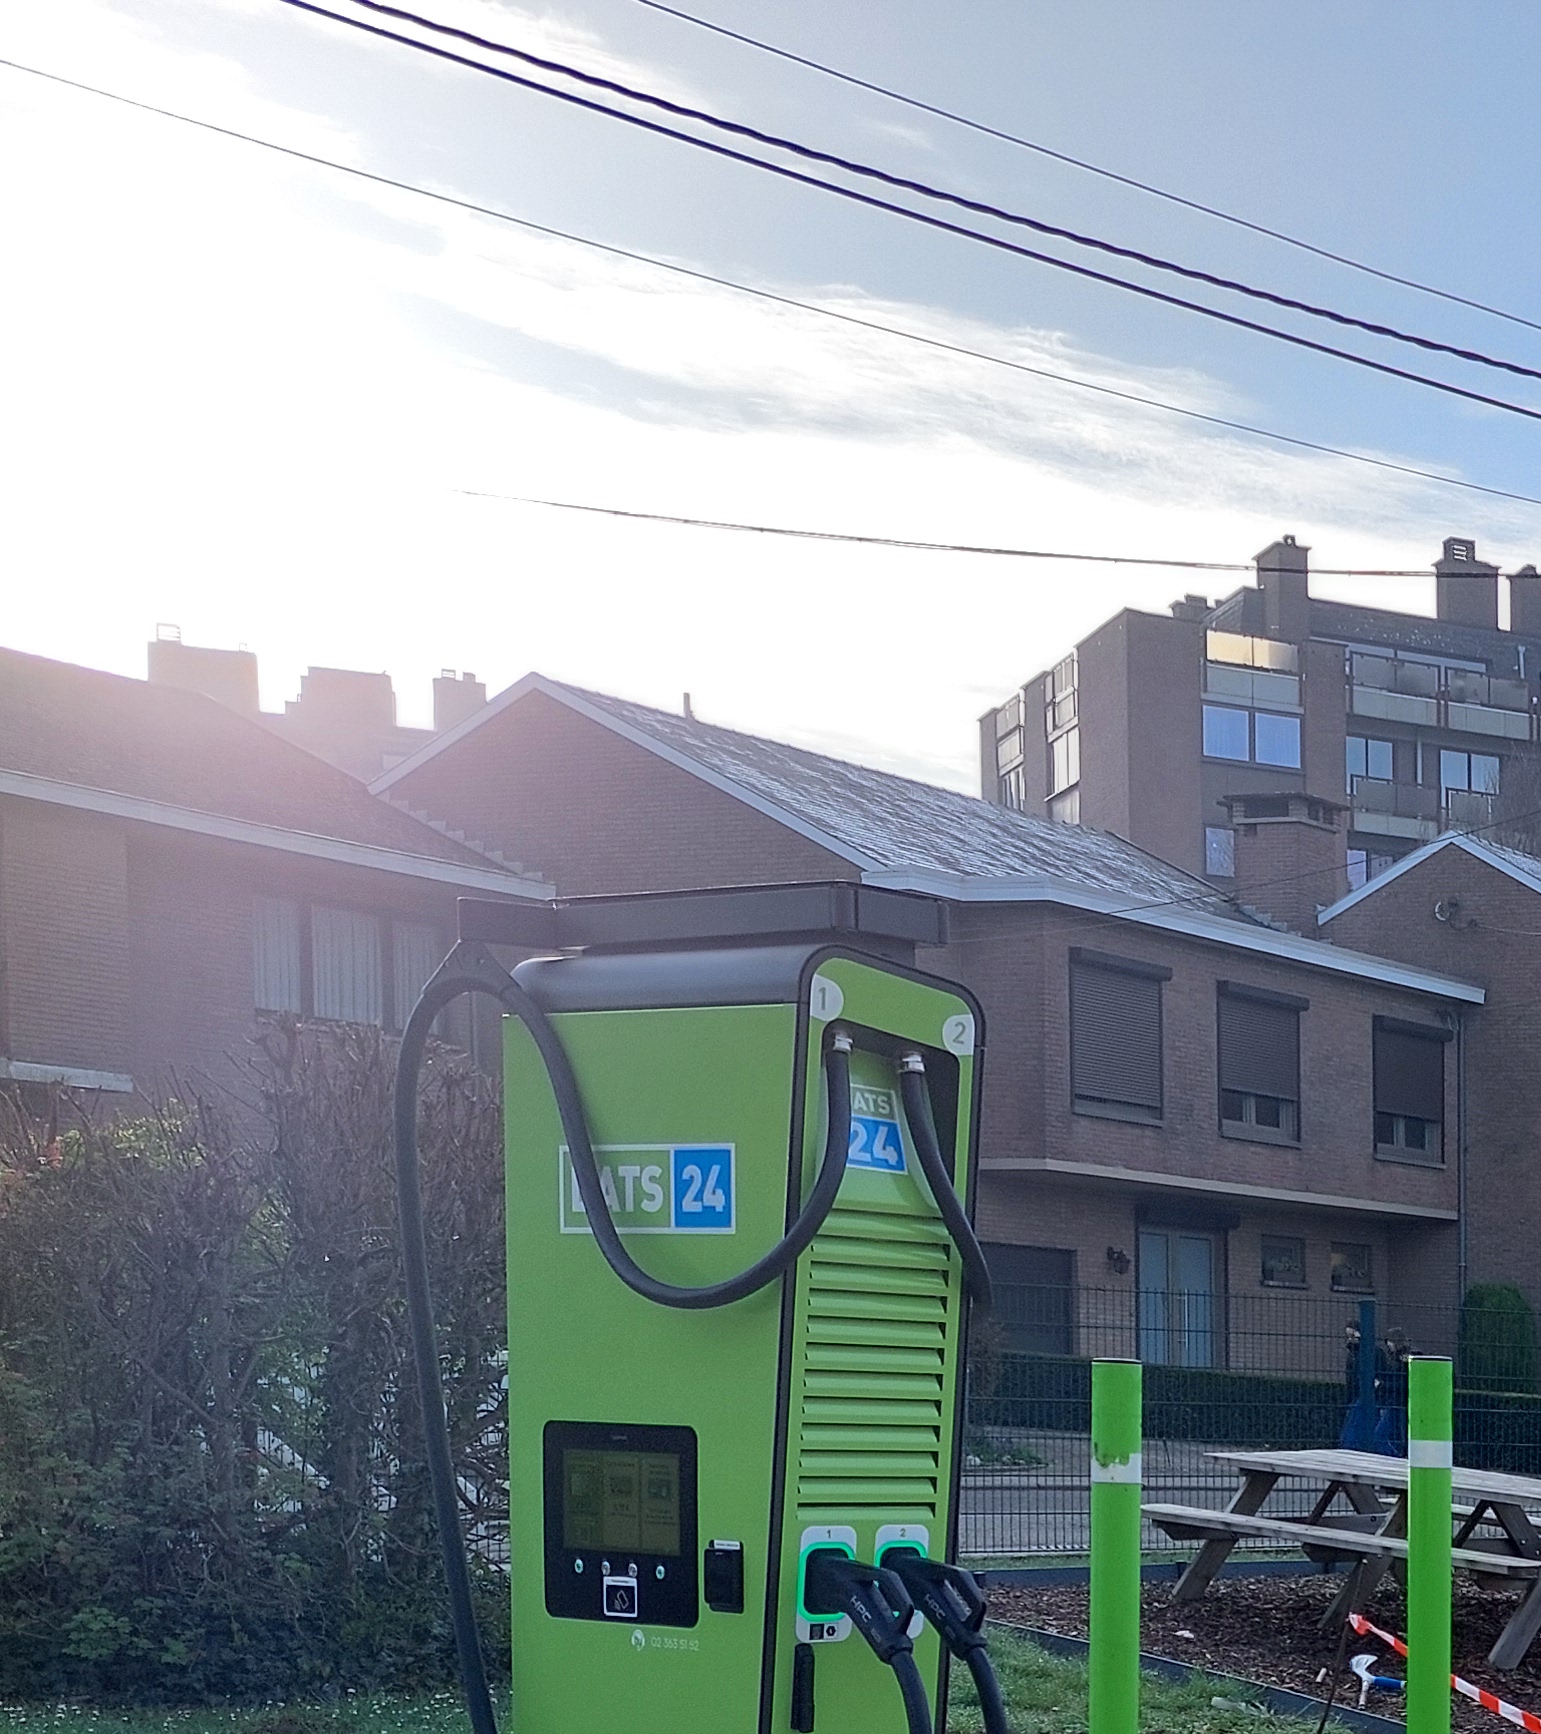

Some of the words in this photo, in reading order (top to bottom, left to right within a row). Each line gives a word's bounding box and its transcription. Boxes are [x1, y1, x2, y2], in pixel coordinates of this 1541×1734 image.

[818, 986, 827, 1011] 1
[952, 1021, 967, 1045] 2
[850, 1090, 891, 1115] ATS
[848, 1121, 900, 1167] 24
[681, 1164, 726, 1213] 24
[899, 1528, 906, 1538] 2
